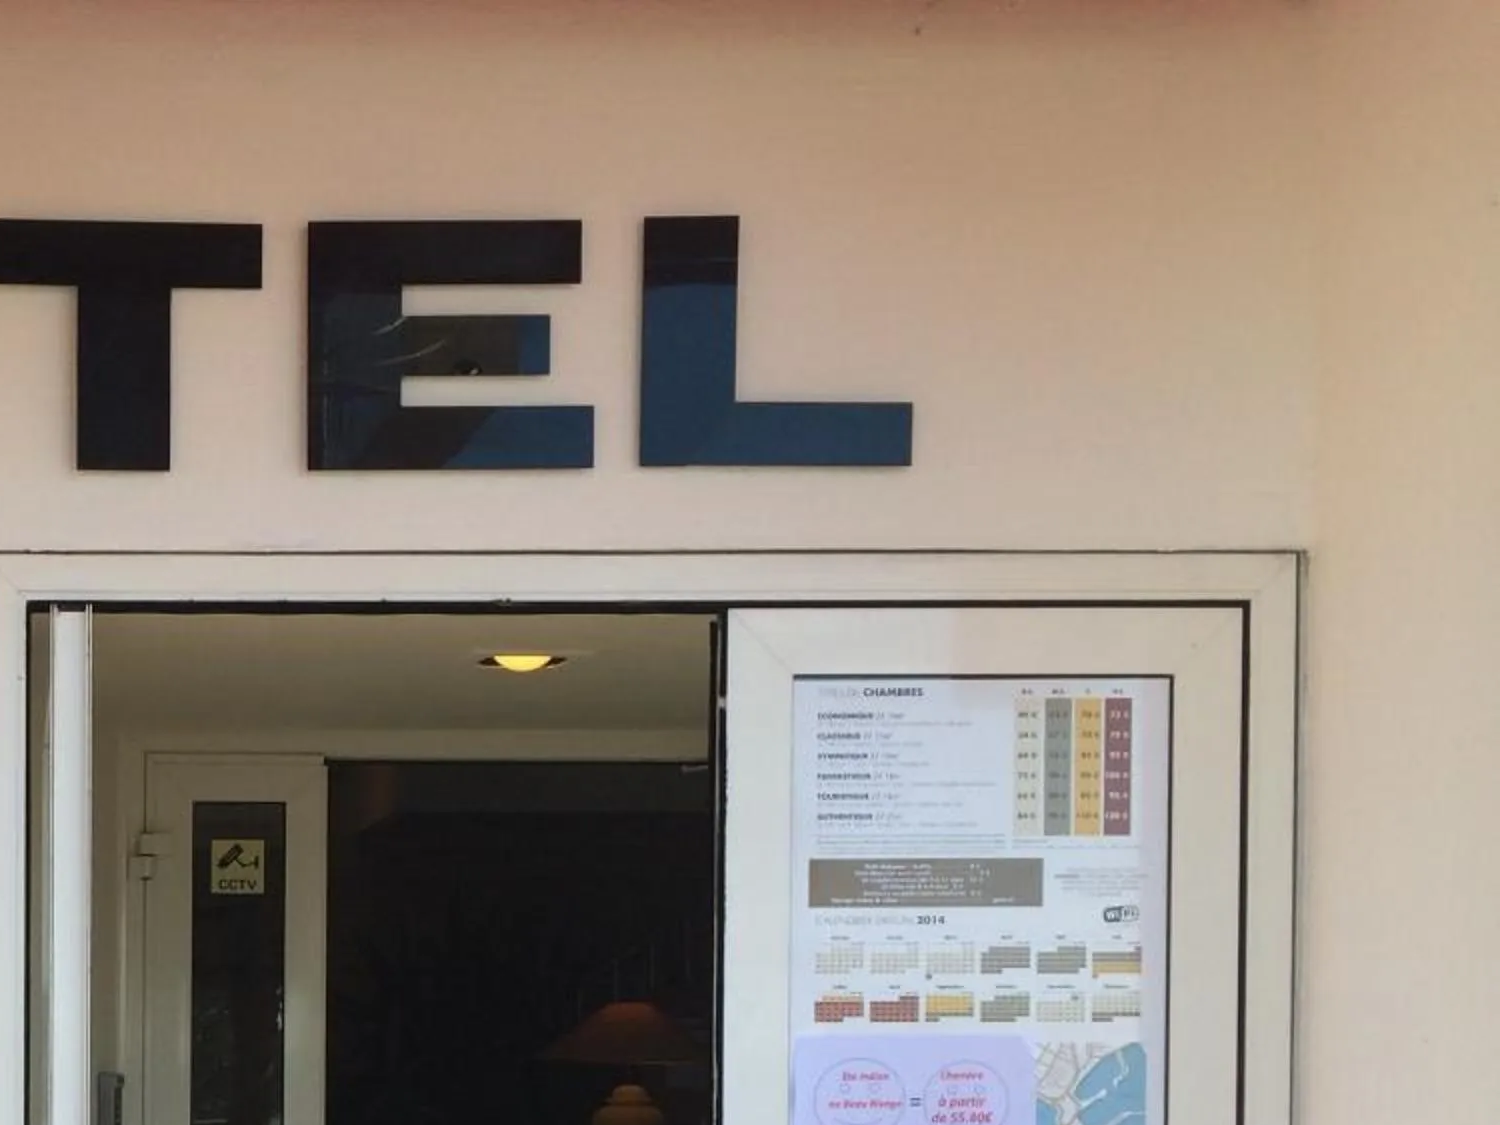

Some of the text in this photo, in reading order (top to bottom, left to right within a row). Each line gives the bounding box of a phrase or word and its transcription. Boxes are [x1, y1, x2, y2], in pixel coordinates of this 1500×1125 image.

[863, 687, 924, 697] CHAMBRES
[218, 879, 258, 890] CCTV
[917, 915, 945, 925] 2014
[949, 1096, 986, 1110] partir
[932, 1112, 946, 1123] de
